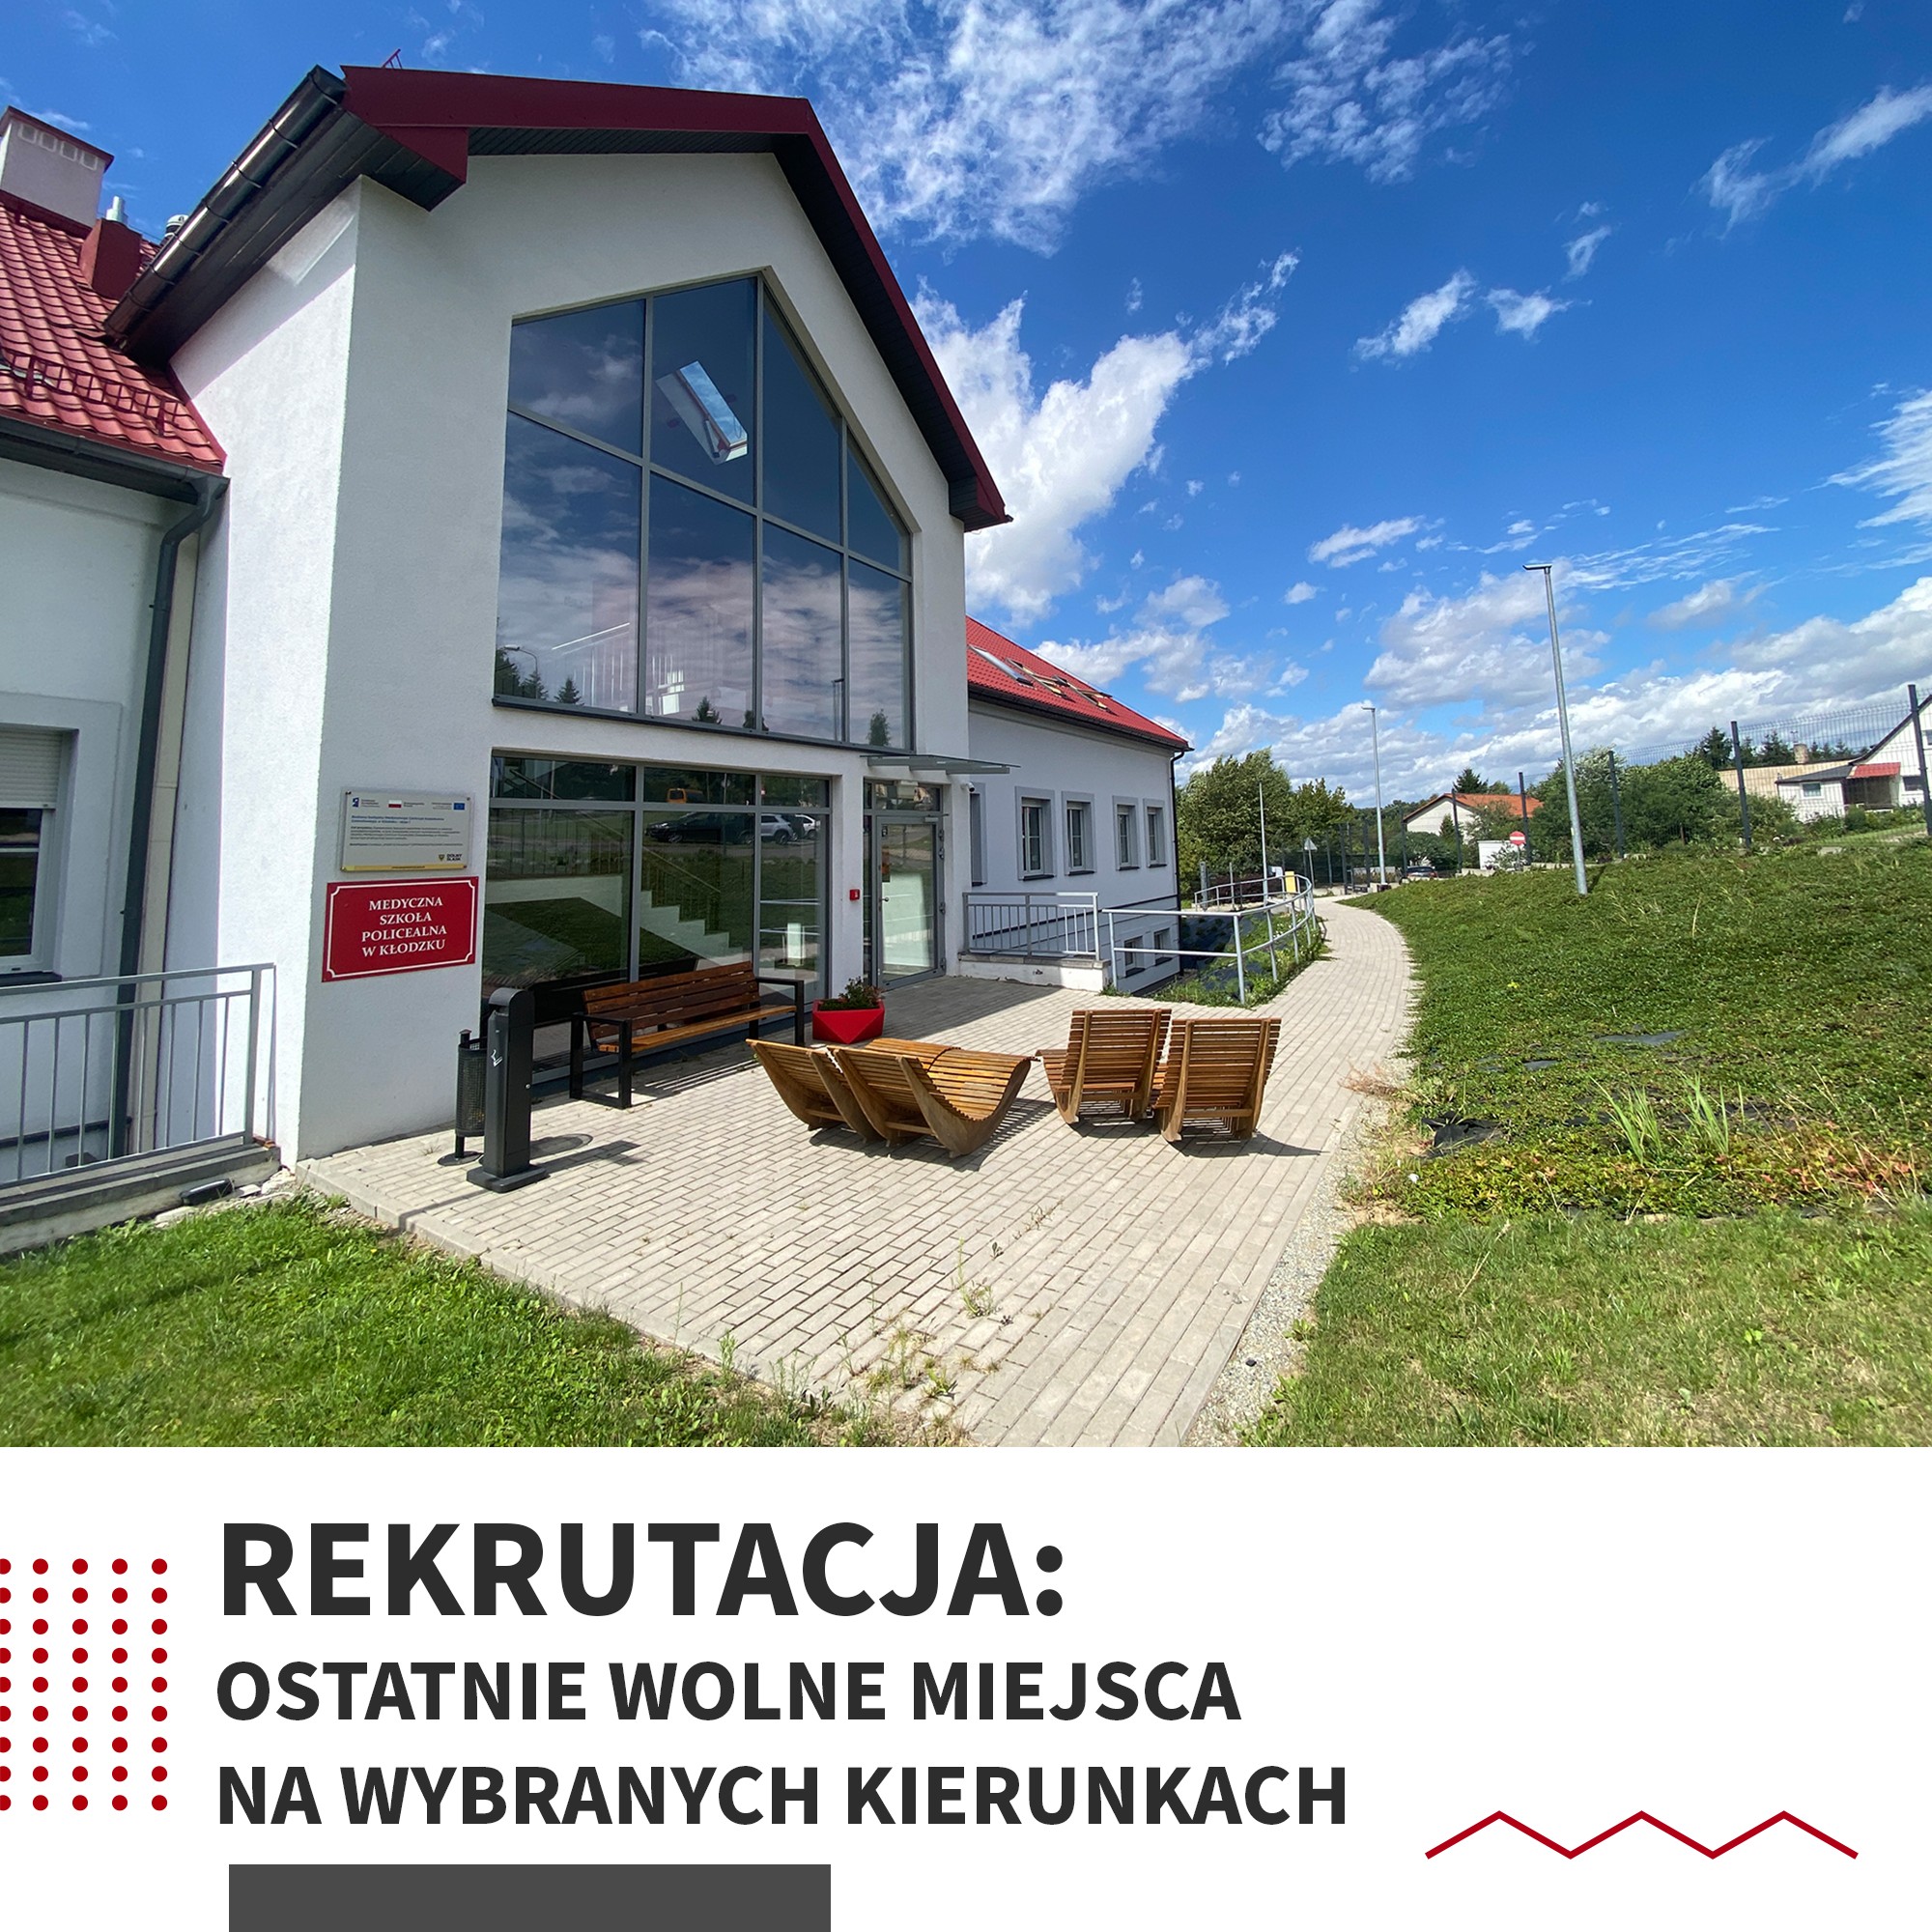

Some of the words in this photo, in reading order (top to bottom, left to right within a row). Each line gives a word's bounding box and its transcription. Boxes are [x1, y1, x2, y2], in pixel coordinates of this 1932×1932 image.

[369, 896, 443, 911] MEDYCZNA
[379, 913, 432, 926] SZKOŁA
[361, 925, 447, 943] POLICEALNA
[362, 947, 377, 957] W
[379, 939, 445, 956] KŁODZKU
